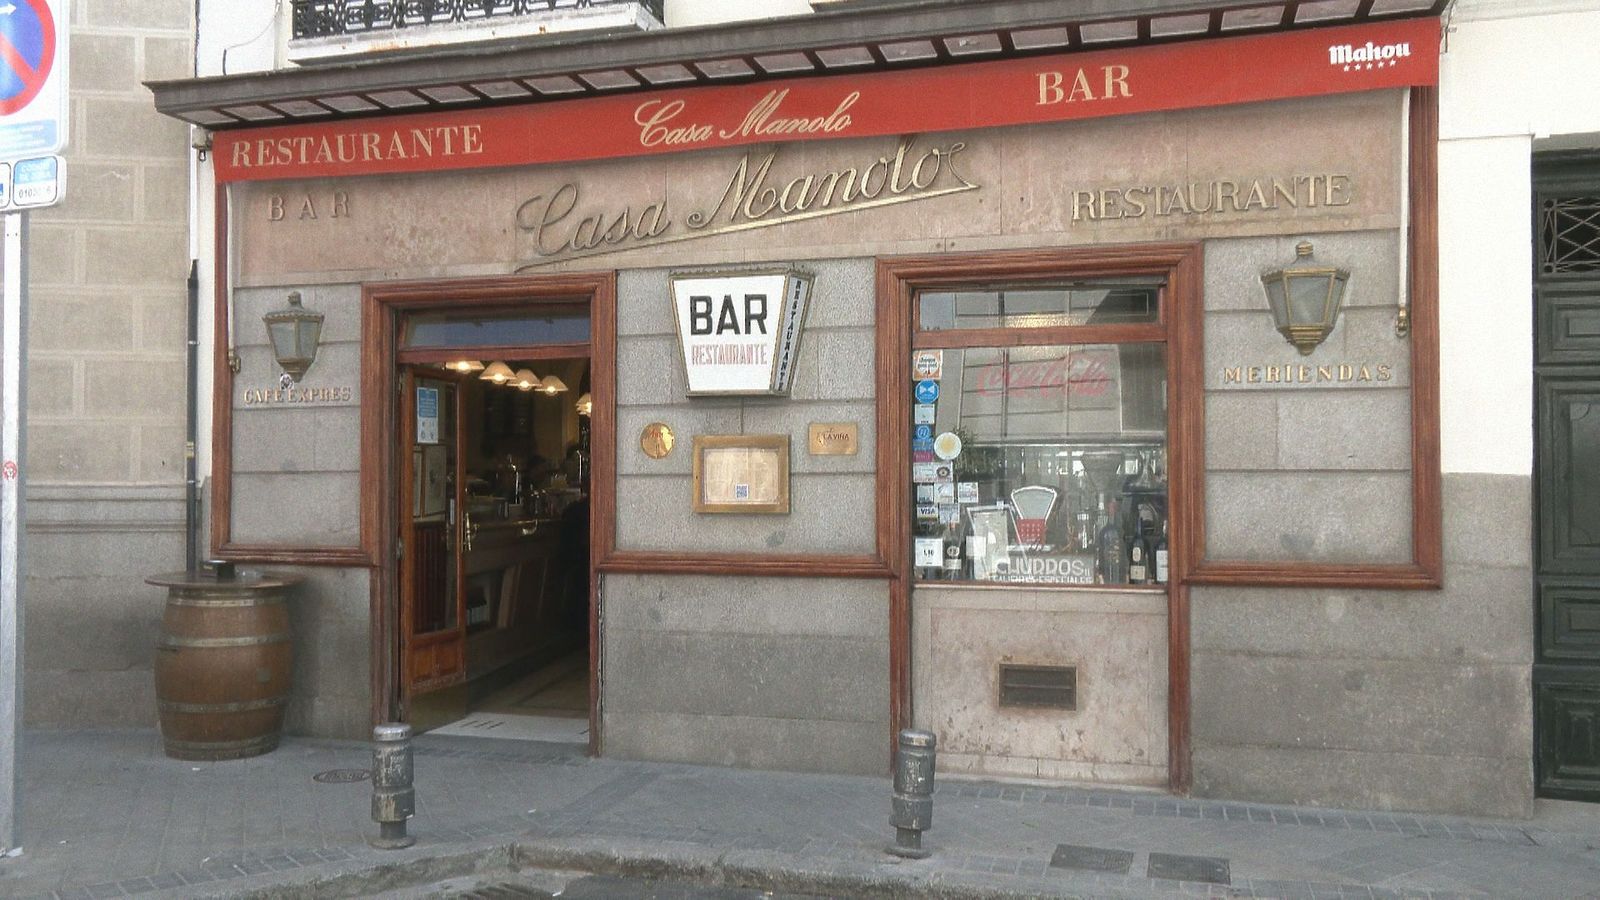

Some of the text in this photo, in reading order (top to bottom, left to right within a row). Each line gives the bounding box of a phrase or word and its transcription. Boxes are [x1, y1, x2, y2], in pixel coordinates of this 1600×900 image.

[1329, 42, 1411, 65] Mahou
[1035, 64, 1134, 106] BAR
[634, 90, 860, 147] Casa Manolo
[230, 123, 483, 169] RESTAURANTE
[267, 190, 350, 222] BAR
[515, 138, 967, 257] Casa Manolo
[1071, 174, 1352, 222] RESTAURANTE
[689, 293, 768, 337] BAR
[777, 279, 802, 392] RESTAURANTE
[691, 342, 768, 367] RESTAURANTE
[1222, 362, 1393, 385] MERIENDAS
[286, 385, 351, 404] EXPRES
[920, 507, 936, 516] VISA
